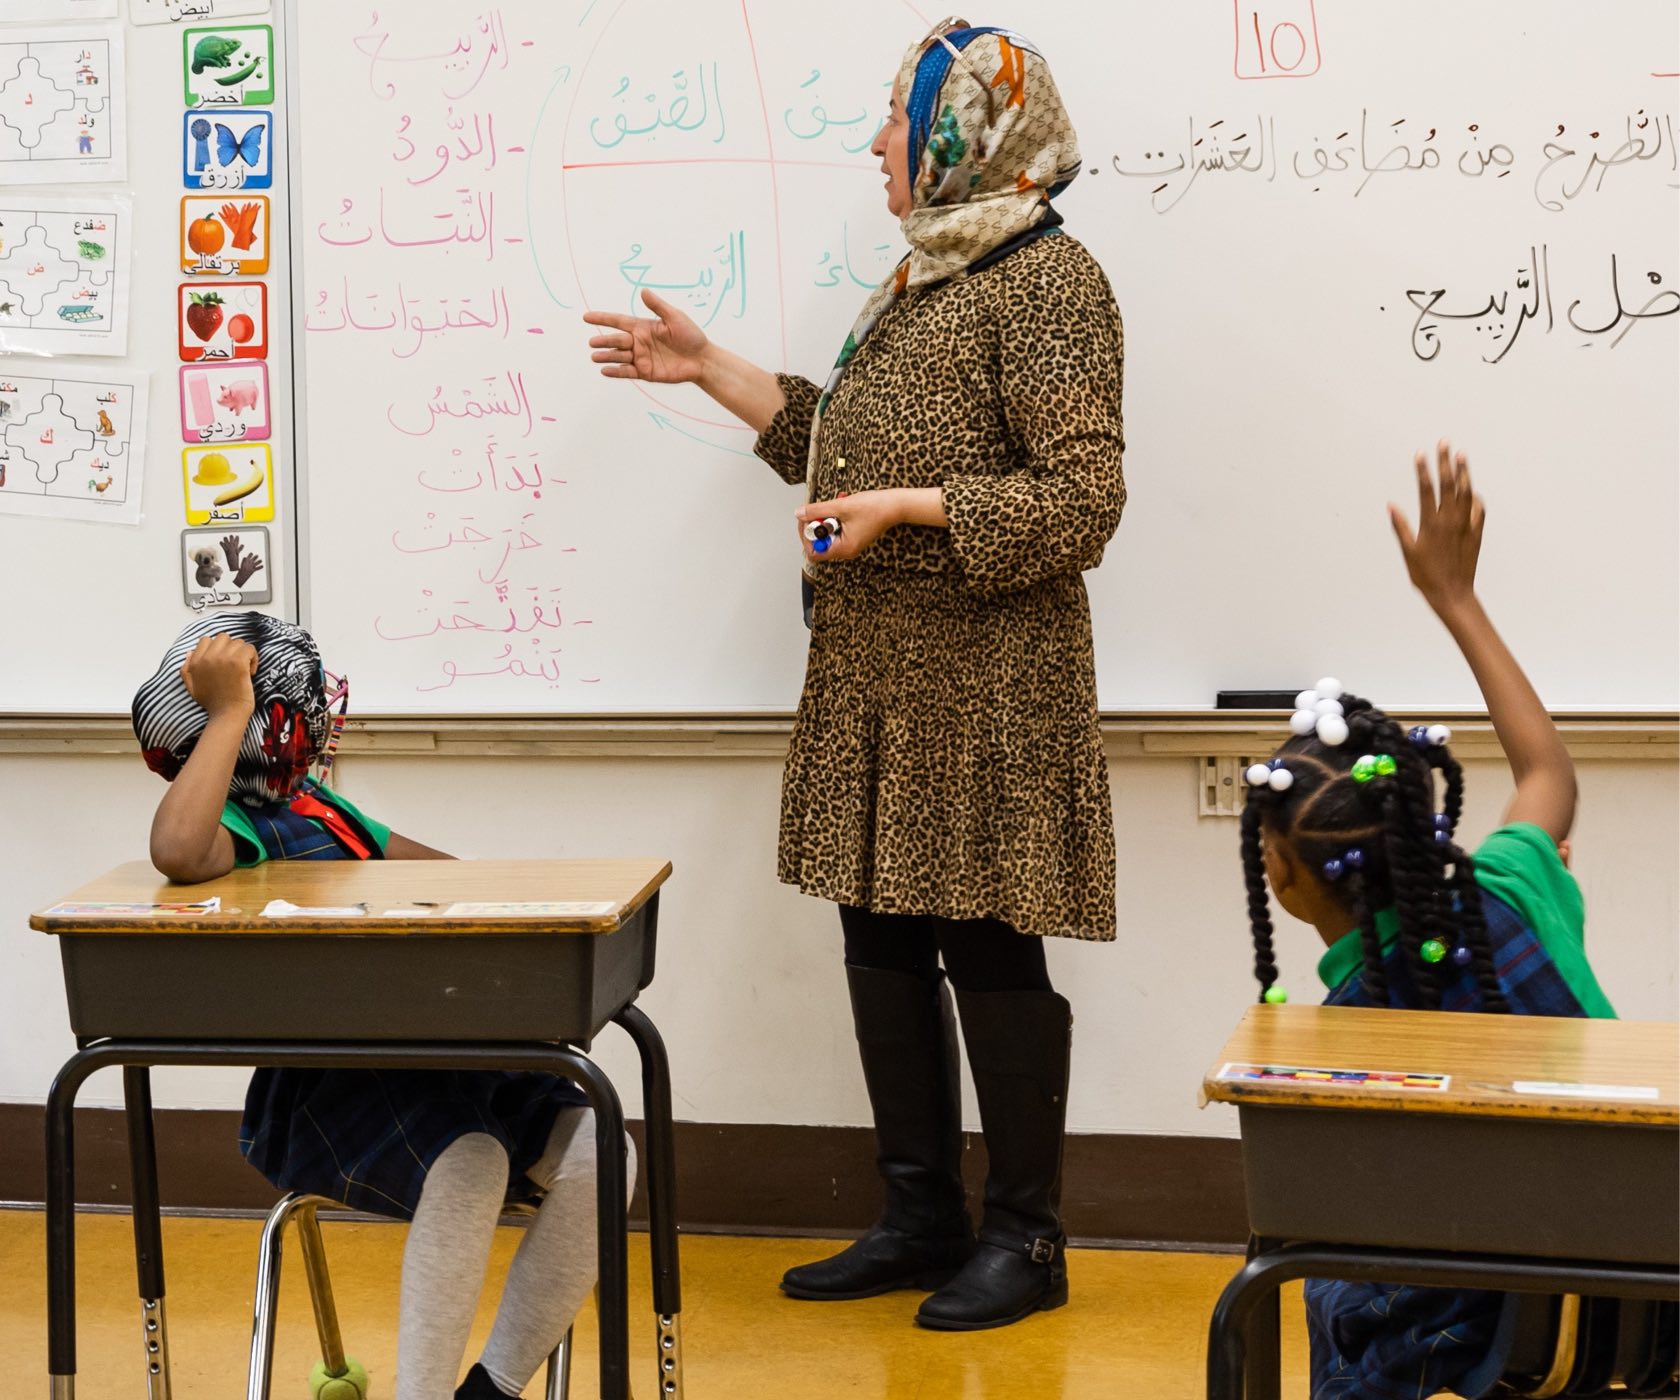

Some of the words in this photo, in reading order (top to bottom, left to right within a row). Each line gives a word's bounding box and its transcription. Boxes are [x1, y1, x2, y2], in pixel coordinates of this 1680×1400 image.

[1254, 11, 1306, 72] 10
[74, 51, 91, 63] دار
[25, 93, 33, 105] د
[193, 84, 244, 108] أخضر
[78, 114, 95, 128] ولد
[200, 166, 245, 189] أزرق
[73, 219, 106, 235] ضفدع
[27, 262, 45, 276] ض
[184, 253, 241, 278] برتقالي
[72, 284, 99, 300] بيض
[194, 338, 235, 361] أحمر
[96, 392, 117, 405] كلب
[39, 429, 54, 444] ك
[199, 422, 246, 443] وردي
[90, 458, 109, 471] ديك
[203, 505, 244, 525] أصفر
[192, 588, 243, 613] رمادي
